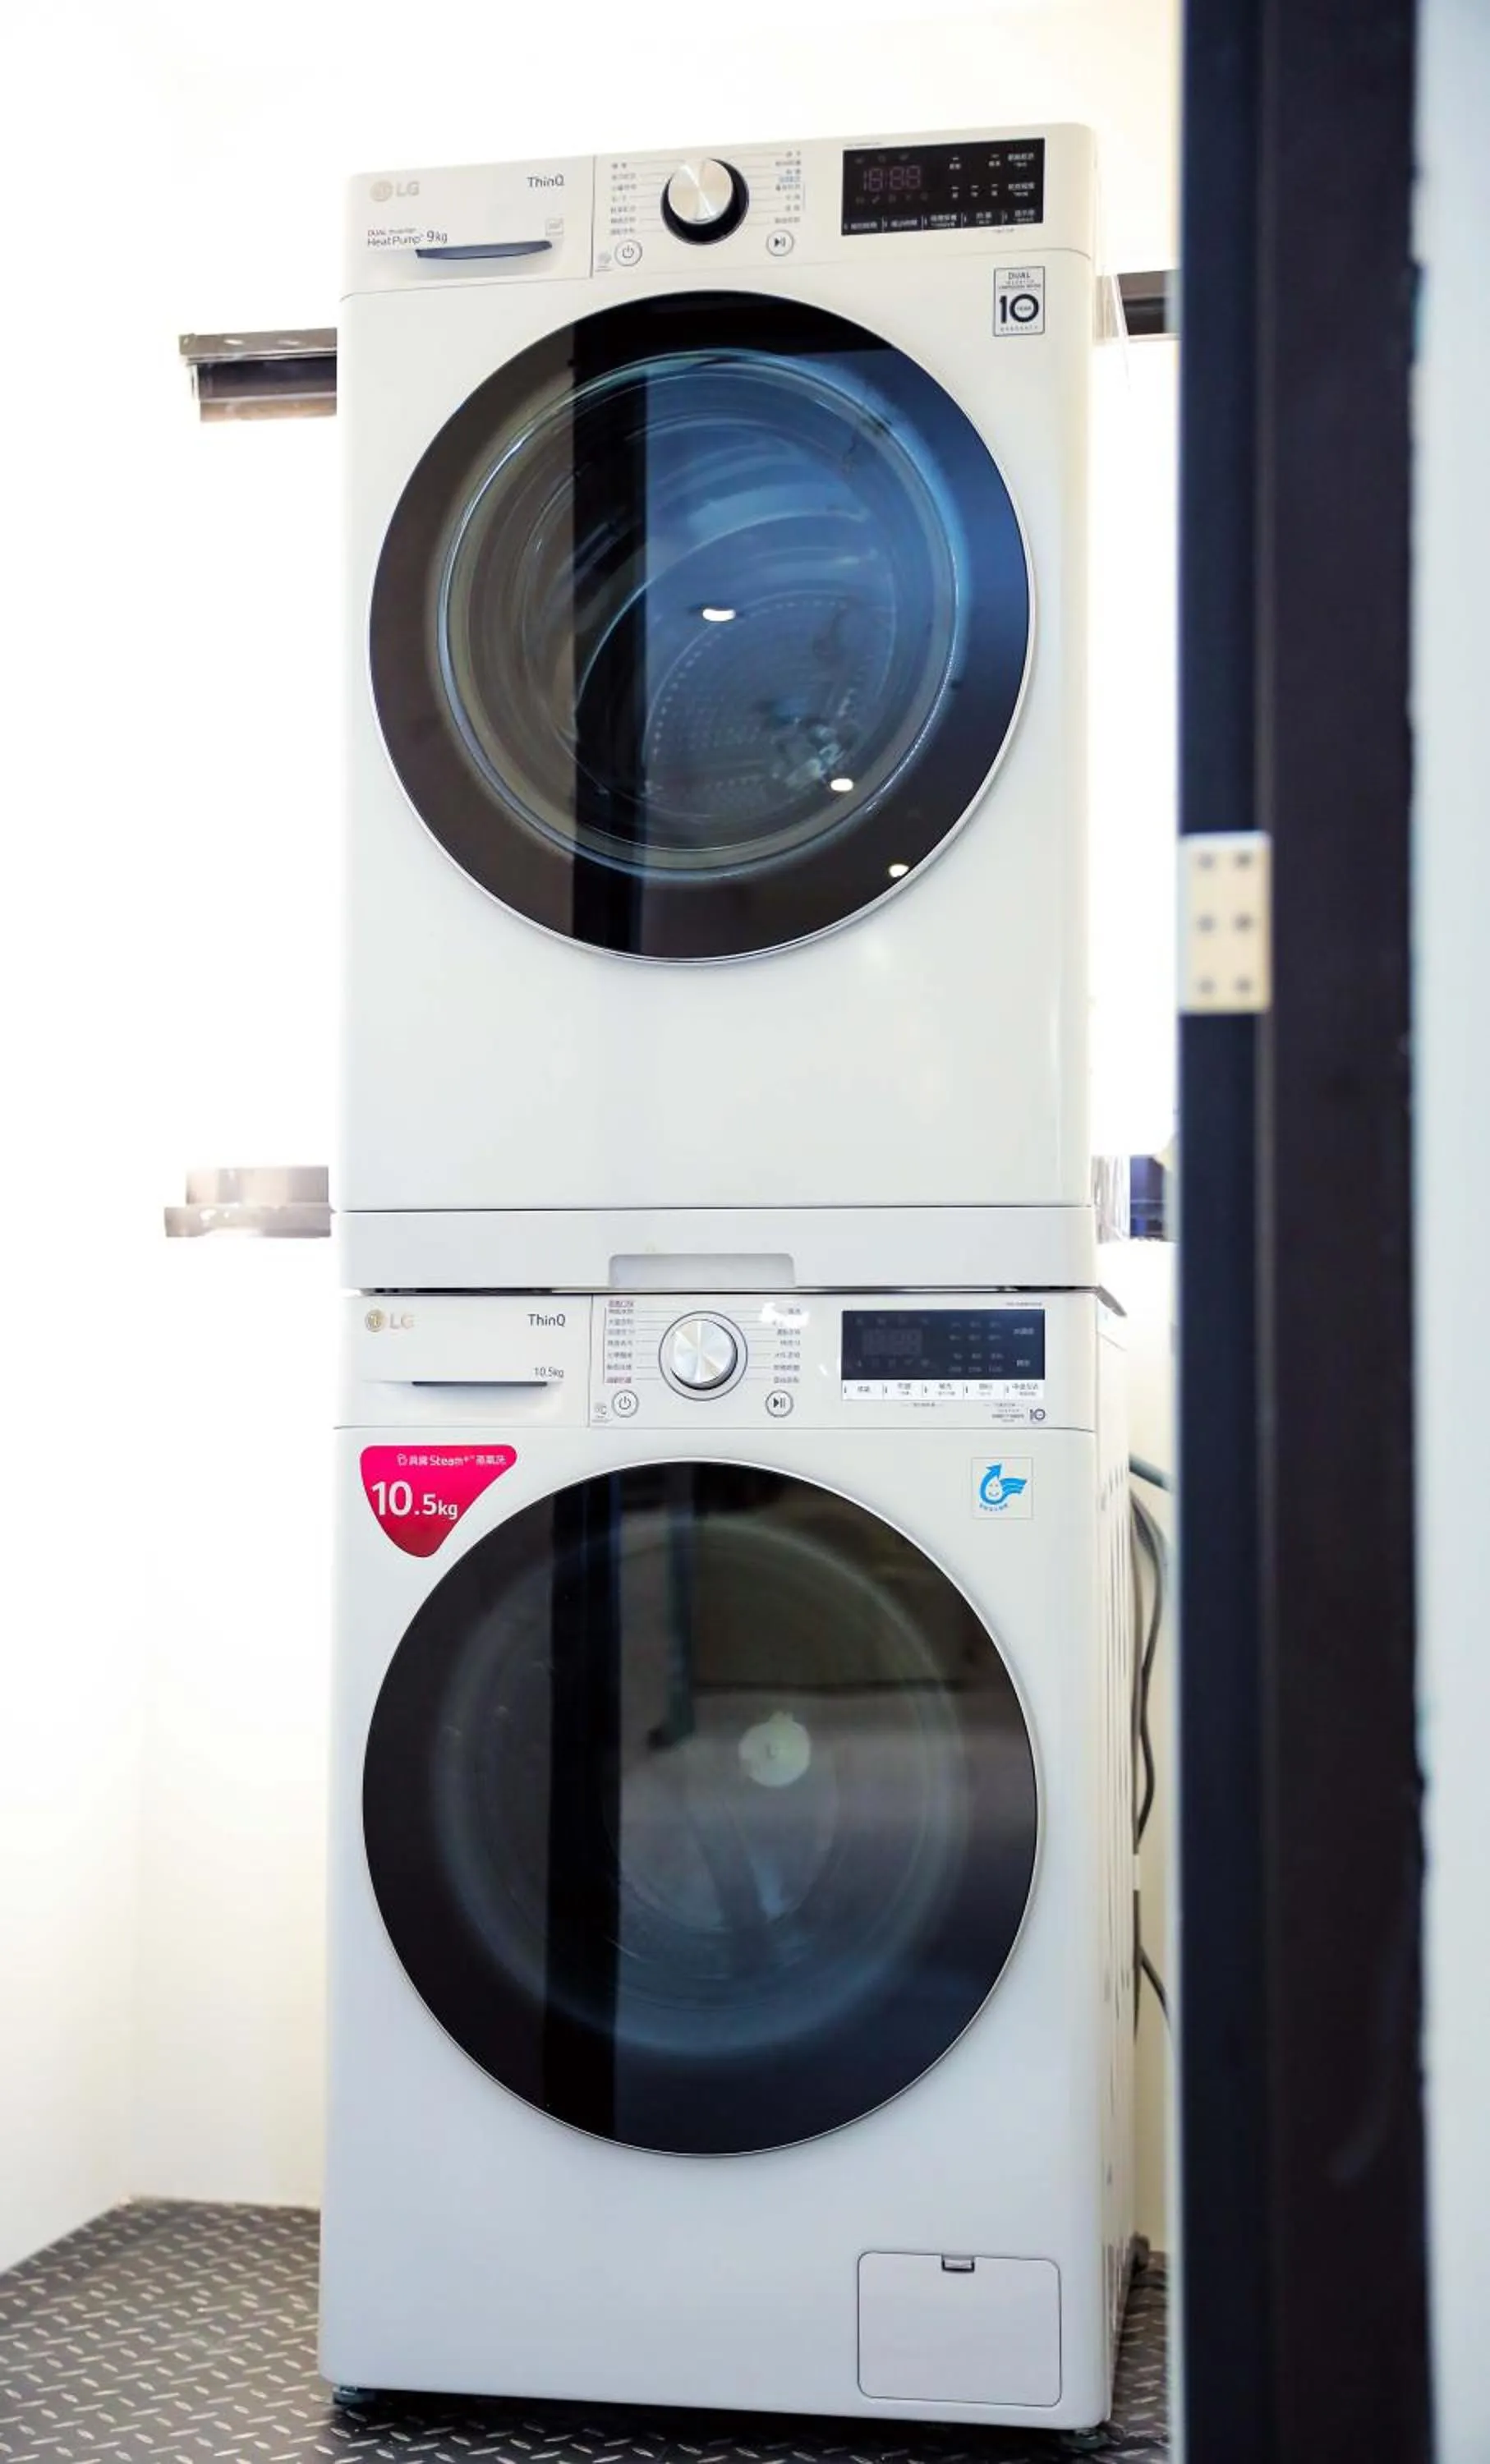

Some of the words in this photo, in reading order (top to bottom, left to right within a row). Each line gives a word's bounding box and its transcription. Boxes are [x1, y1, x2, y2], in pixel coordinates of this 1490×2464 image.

[527, 173, 565, 188] ThinQ
[395, 181, 420, 197] LG
[426, 229, 448, 244] 9kg
[999, 292, 1040, 324] 10
[389, 1313, 414, 1329] LG
[527, 1313, 566, 1327] ThinQ
[534, 1366, 564, 1378] 10.5kg
